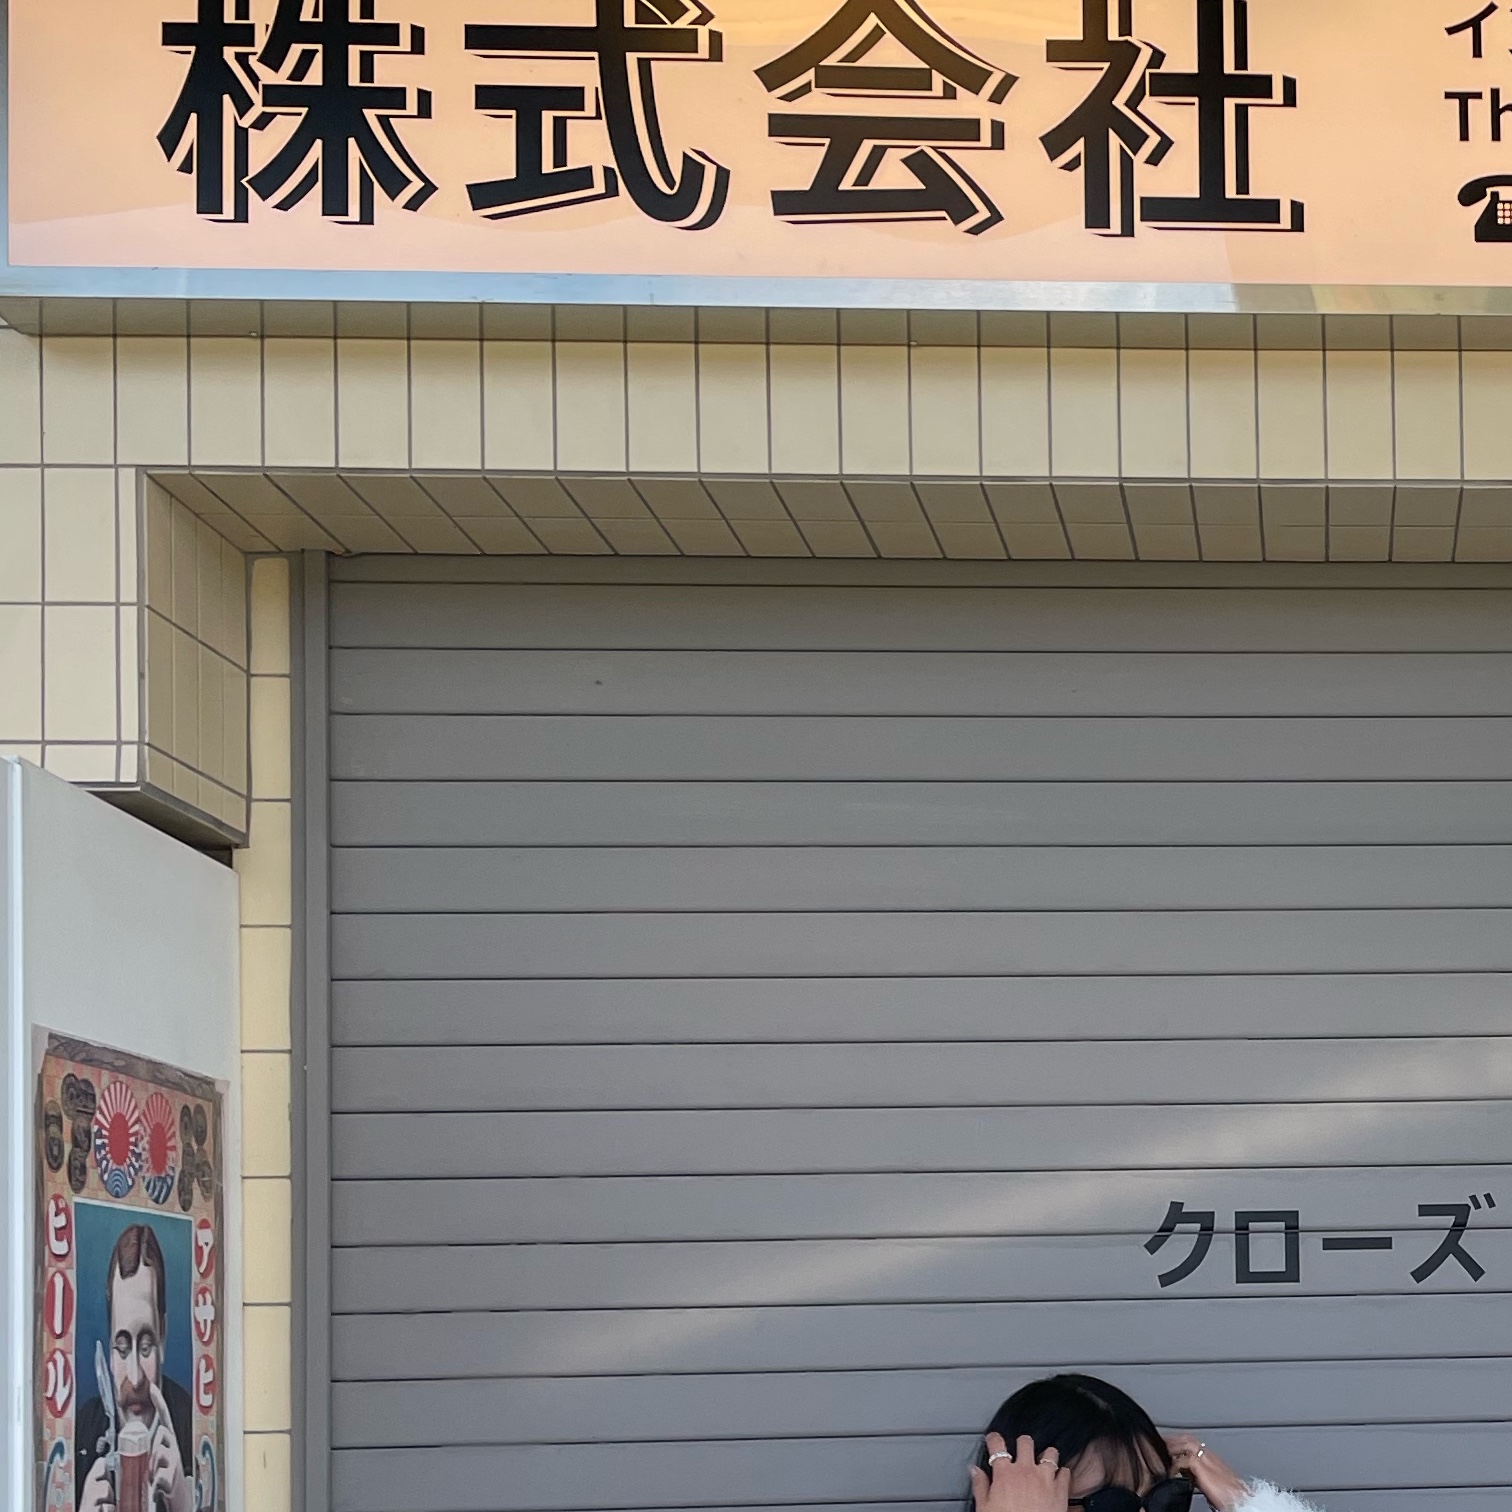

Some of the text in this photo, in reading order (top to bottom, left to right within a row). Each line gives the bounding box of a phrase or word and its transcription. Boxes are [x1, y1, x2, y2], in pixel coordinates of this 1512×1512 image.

[156, 0, 1305, 238] 株式会社
[46, 1197, 71, 1412] ビール
[194, 1227, 216, 1408] アサヒ
[1143, 1192, 1497, 1288] クローズ
